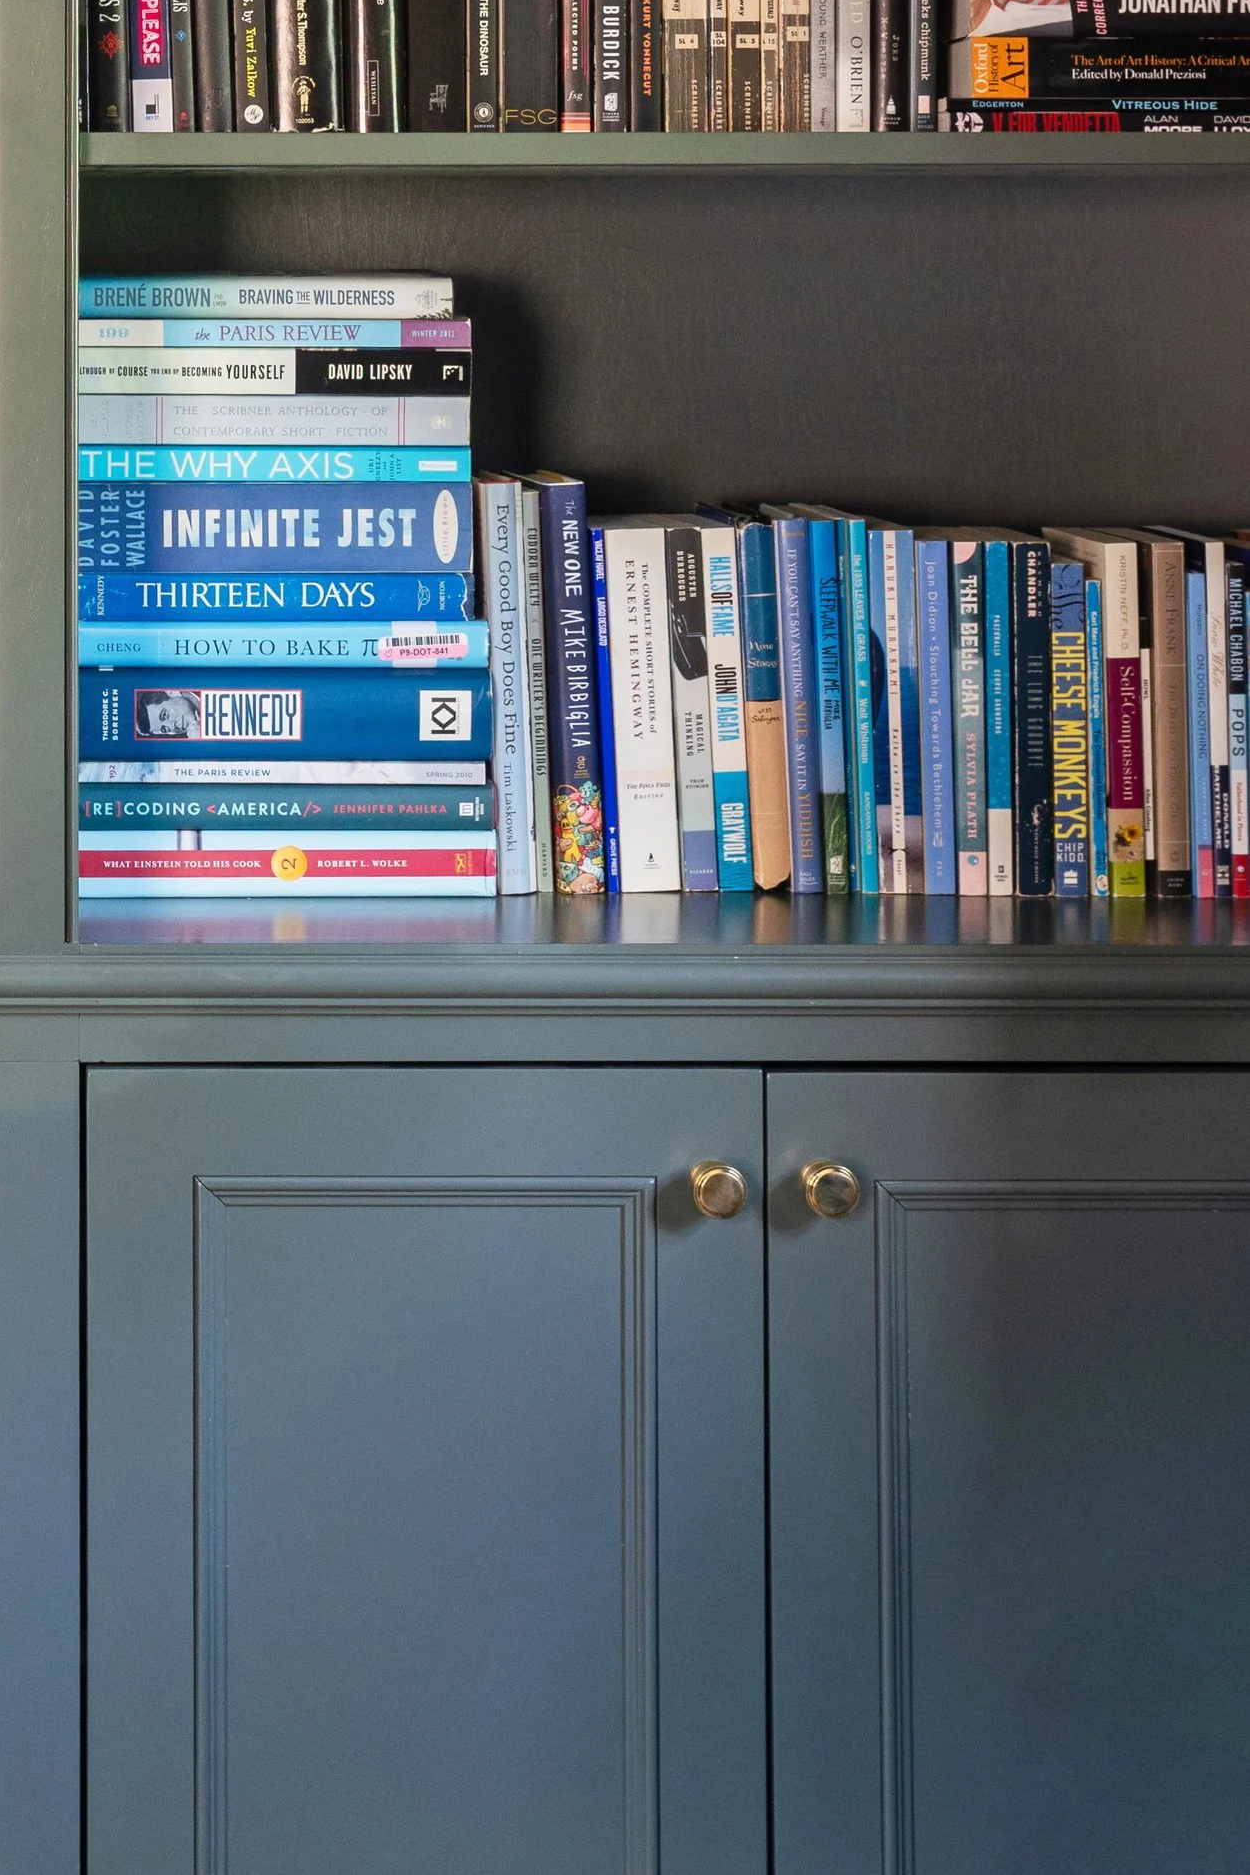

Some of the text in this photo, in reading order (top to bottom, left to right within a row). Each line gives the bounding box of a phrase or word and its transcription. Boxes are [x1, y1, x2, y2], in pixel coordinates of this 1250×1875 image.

[479, 20, 488, 76] DINOSAUR
[603, 7, 619, 81] BURDICK
[974, 43, 989, 94] Oxford
[1000, 44, 1025, 92] Art
[1112, 99, 1180, 110] VITREOUS
[1184, 100, 1218, 110] HIDE
[94, 284, 394, 307] BRENÉ BROWN BRAVING THE WILDERNESS
[195, 325, 361, 341] the PARIS REVIEW
[81, 451, 353, 479] THE WHY AXIS
[163, 509, 416, 548] INFINITE JEST
[136, 581, 374, 608] THIRTEEN DAYS
[175, 639, 349, 656] HOW TO BAKE
[492, 504, 516, 755] Every Good Boy Does Fine
[561, 519, 591, 748] NEW ONE MIKE BIRBIGLIA
[399, 647, 448, 657] P9-DOT-841
[205, 694, 297, 736] KENNEDY
[1051, 631, 1086, 838] CHEESE MONKEYS
